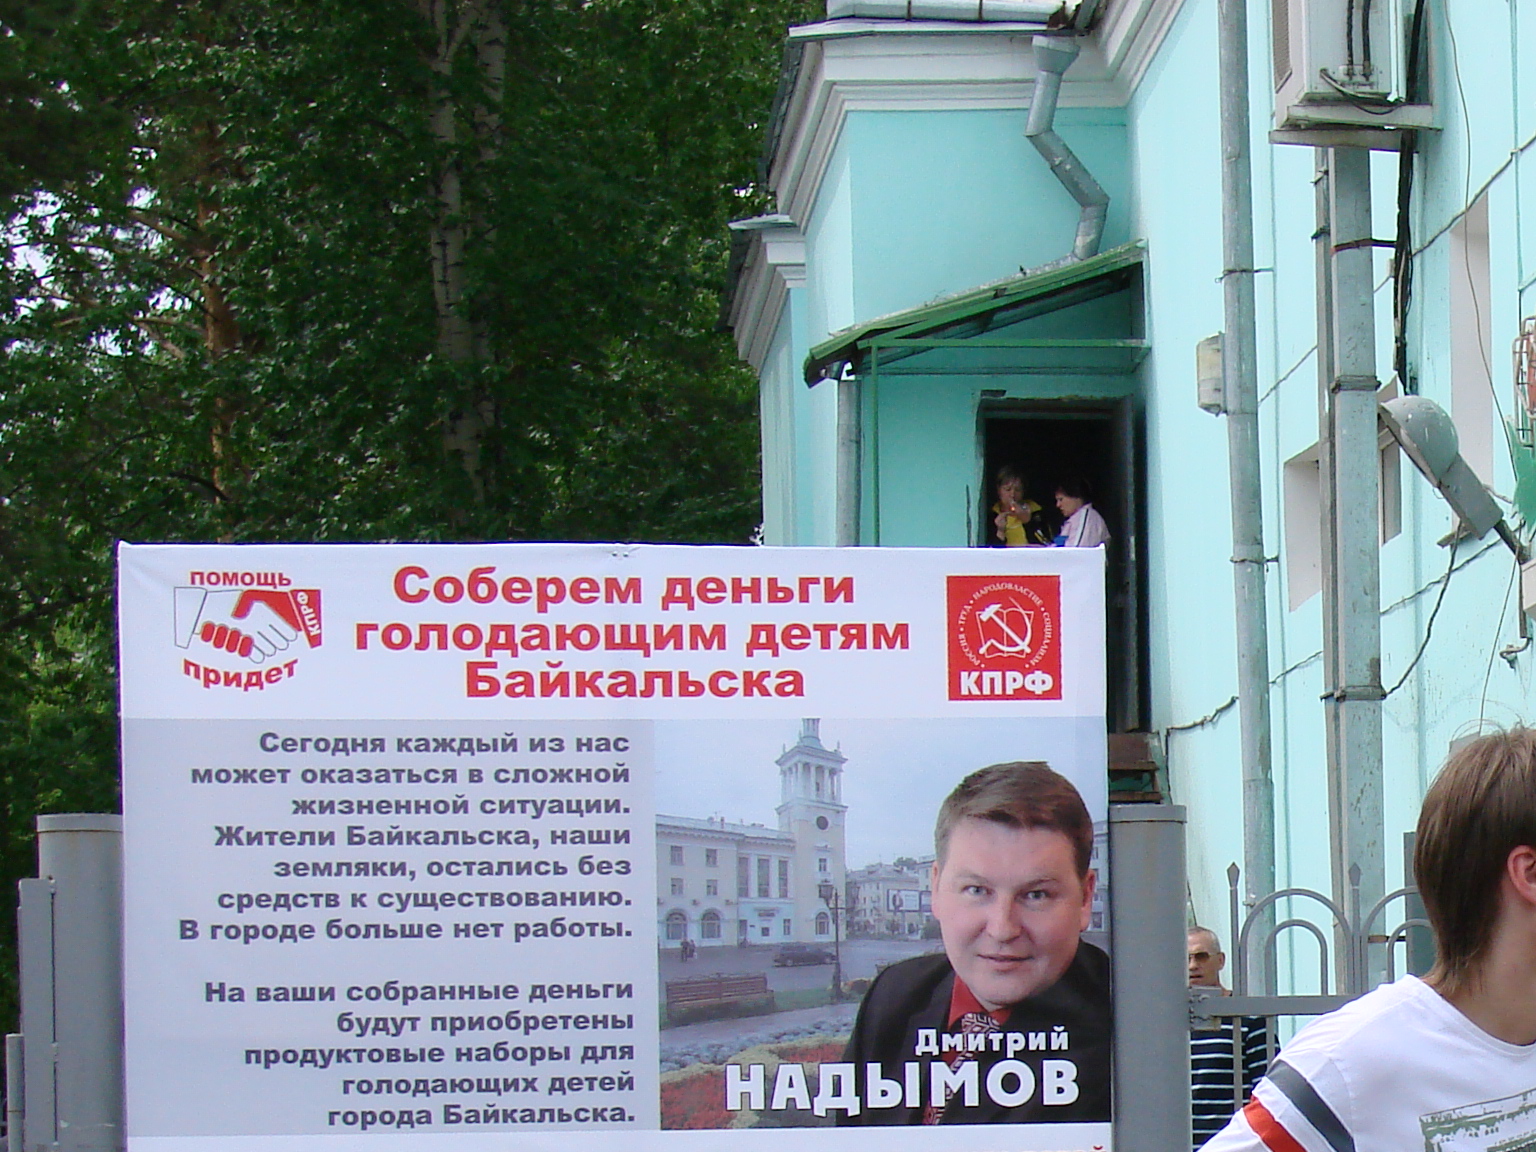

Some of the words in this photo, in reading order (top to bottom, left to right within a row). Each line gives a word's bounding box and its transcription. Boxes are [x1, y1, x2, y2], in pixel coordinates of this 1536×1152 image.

[394, 566, 641, 607] Соберем
[662, 577, 853, 611] деньги
[297, 592, 321, 637] КПРФ
[357, 623, 726, 657] голодающим
[747, 624, 909, 657] детям
[183, 658, 299, 691] придет
[467, 661, 804, 698] Байкальска
[960, 670, 1053, 695] КПРФ
[260, 732, 385, 756] Сегодня
[397, 733, 517, 756] каждый
[530, 738, 564, 752] из
[577, 737, 629, 752] нас
[192, 769, 290, 783] может
[301, 769, 456, 783] оказаться
[469, 769, 483, 783] в
[494, 763, 629, 783] сложной
[292, 794, 468, 814] жизненной
[480, 799, 629, 819] ситуации.
[215, 826, 334, 845] Жители
[347, 826, 538, 849] Байкальска,
[551, 830, 630, 844] наши
[274, 862, 415, 881] земляки,
[427, 861, 567, 876] остались
[579, 855, 631, 875] без
[218, 893, 339, 913] средств
[351, 893, 367, 907] к
[378, 891, 631, 912] существованию.
[180, 920, 198, 939] В
[211, 925, 315, 944] городе
[326, 919, 442, 939] больше
[454, 923, 504, 937] нет
[515, 917, 631, 942] работы.
[206, 983, 244, 1002] На
[257, 987, 334, 1001] ваши
[347, 981, 518, 1005] собранные
[529, 984, 632, 1003] деньги
[337, 1012, 420, 1037] будут
[431, 1010, 633, 1036] приобретены
[245, 1048, 444, 1069] продуктовые
[456, 1041, 570, 1066] наборы
[581, 1046, 633, 1064] для
[915, 1028, 1070, 1059] Дмитрий
[343, 1078, 537, 1097] голодающих
[549, 1071, 633, 1095] детей
[726, 1060, 1080, 1118] НАДЫМОВ
[329, 1110, 431, 1130] города
[444, 1104, 634, 1124] Байкальска.
